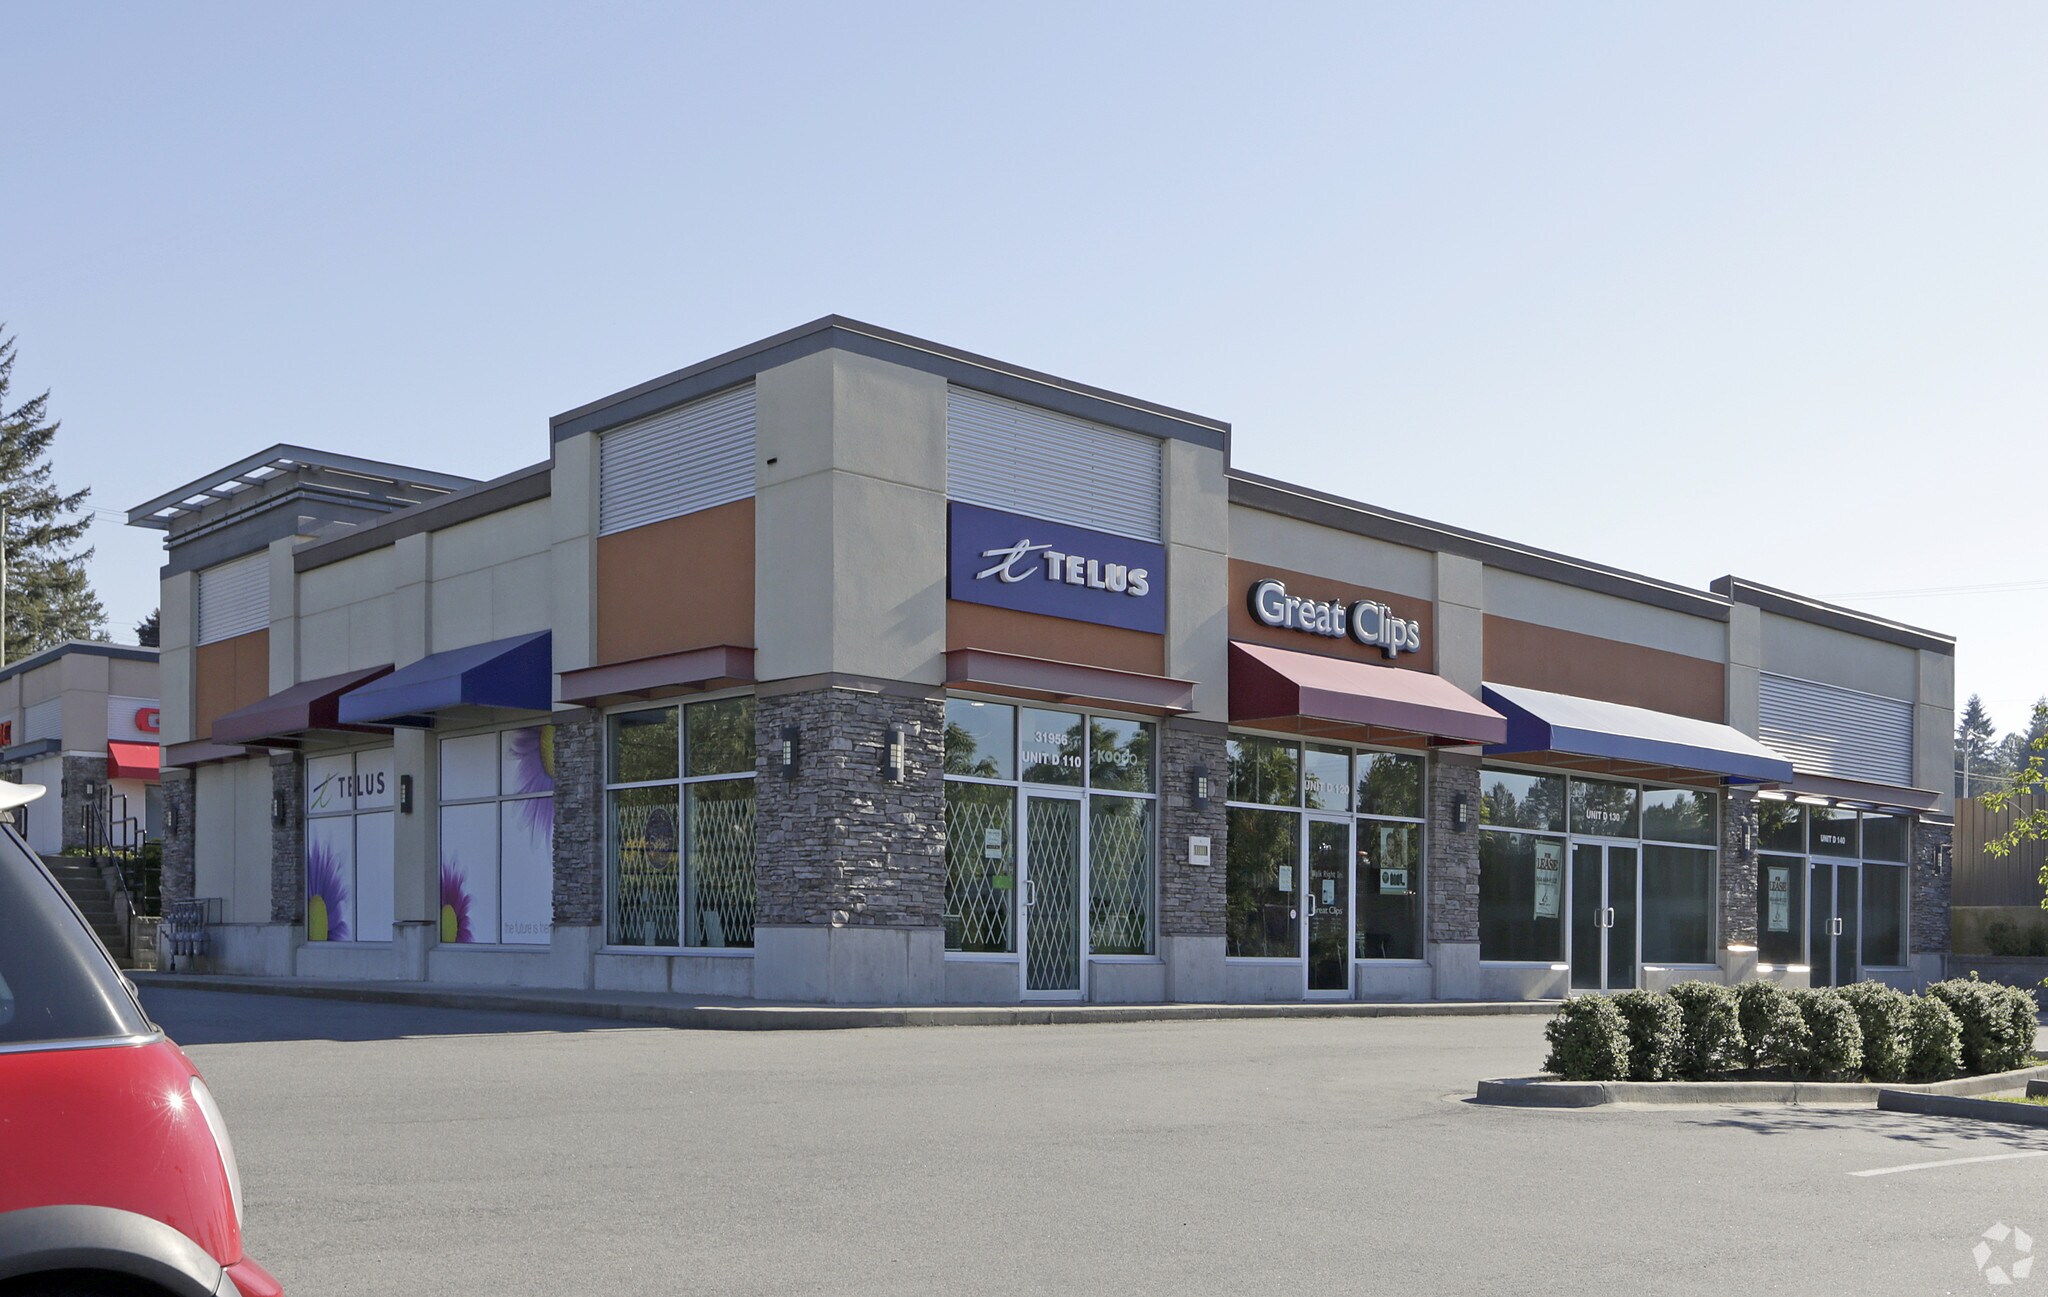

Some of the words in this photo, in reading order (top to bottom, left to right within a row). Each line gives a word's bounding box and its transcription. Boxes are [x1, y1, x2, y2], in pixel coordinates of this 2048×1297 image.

[1044, 550, 1149, 596] TELUS
[1249, 579, 1347, 638] Great
[1349, 600, 1420, 660] Clips
[1035, 731, 1068, 746] 31956
[1022, 750, 1049, 765] UNIT
[1051, 753, 1060, 766] D
[1062, 755, 1081, 768] 110
[338, 771, 385, 798] TELUS
[1305, 780, 1325, 792] UNIT
[1326, 783, 1333, 793] D
[1334, 784, 1350, 795] 120
[1586, 809, 1602, 820] UNIT
[1602, 811, 1608, 821] D
[1609, 812, 1620, 822] 130
[1820, 834, 1832, 843] UNIT
[1537, 857, 1559, 871] LEASE
